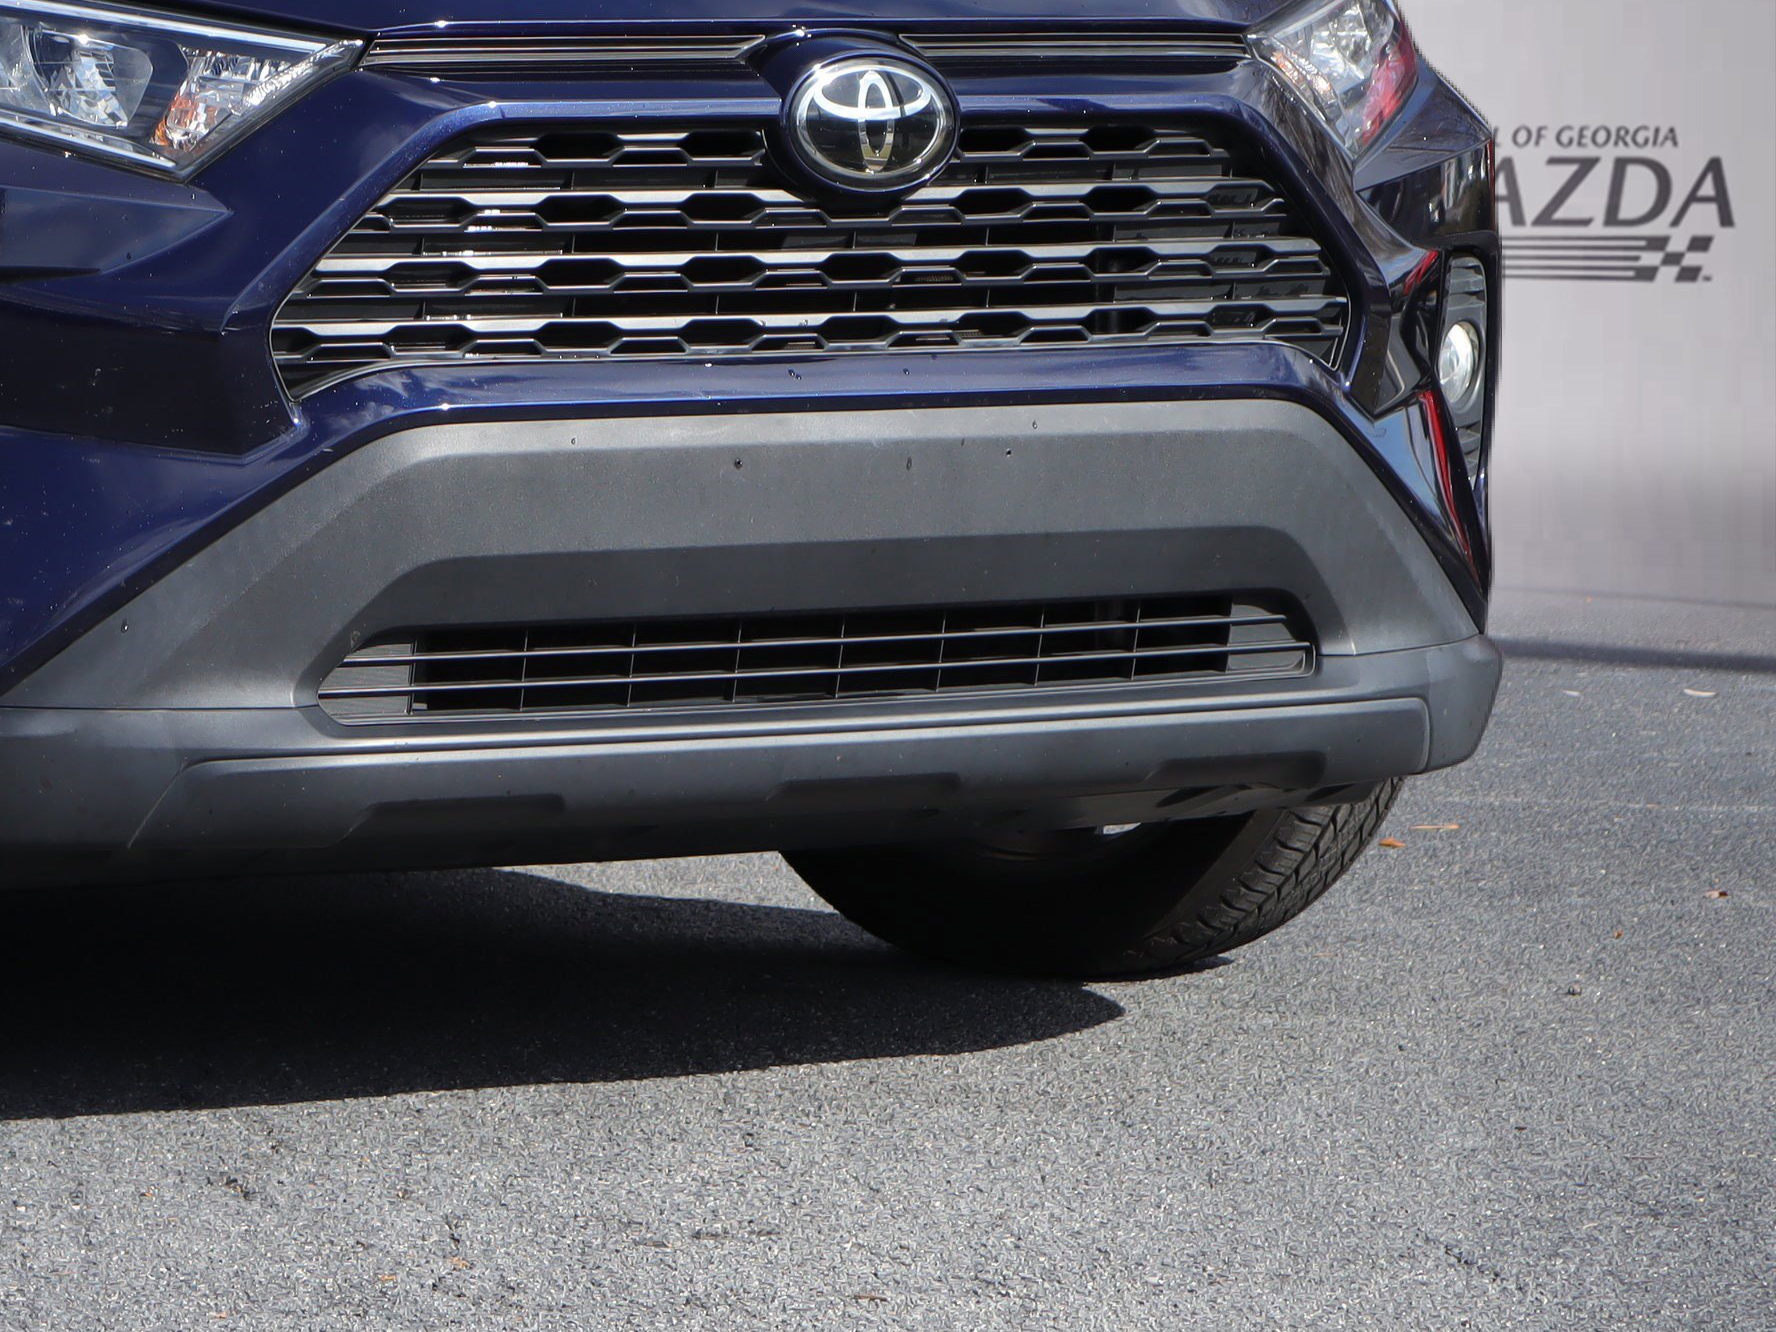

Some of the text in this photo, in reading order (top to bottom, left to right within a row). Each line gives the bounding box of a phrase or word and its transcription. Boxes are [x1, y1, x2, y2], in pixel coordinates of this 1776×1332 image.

[1512, 125, 1548, 148] OF
[1555, 124, 1679, 149] GEORGIA
[1495, 155, 1736, 228] AZDA
